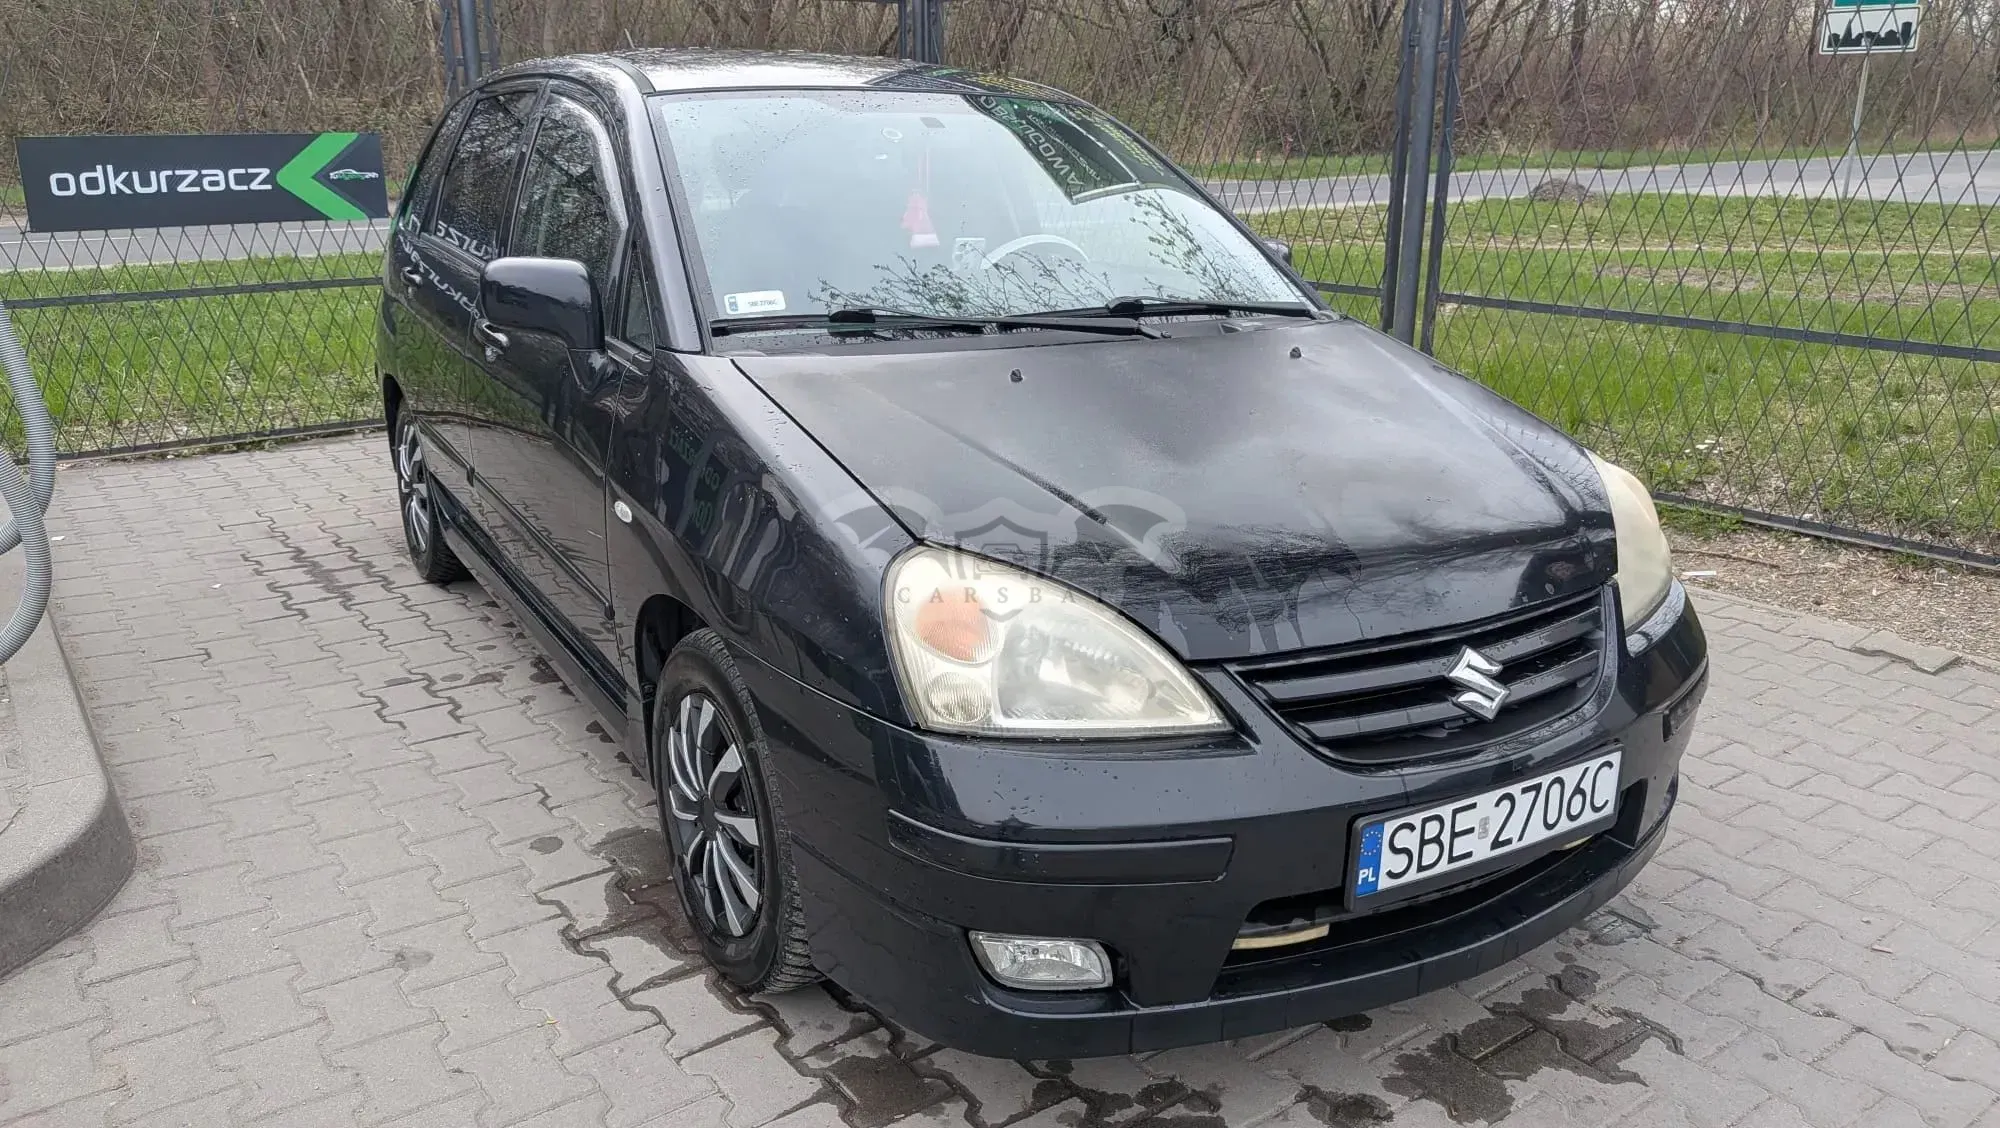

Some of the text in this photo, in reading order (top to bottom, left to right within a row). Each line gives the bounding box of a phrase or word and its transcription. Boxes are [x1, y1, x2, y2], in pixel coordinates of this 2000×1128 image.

[49, 164, 273, 197] odkurzacz
[1385, 760, 1614, 880] SBE 2706C
[1358, 866, 1376, 885] PL
